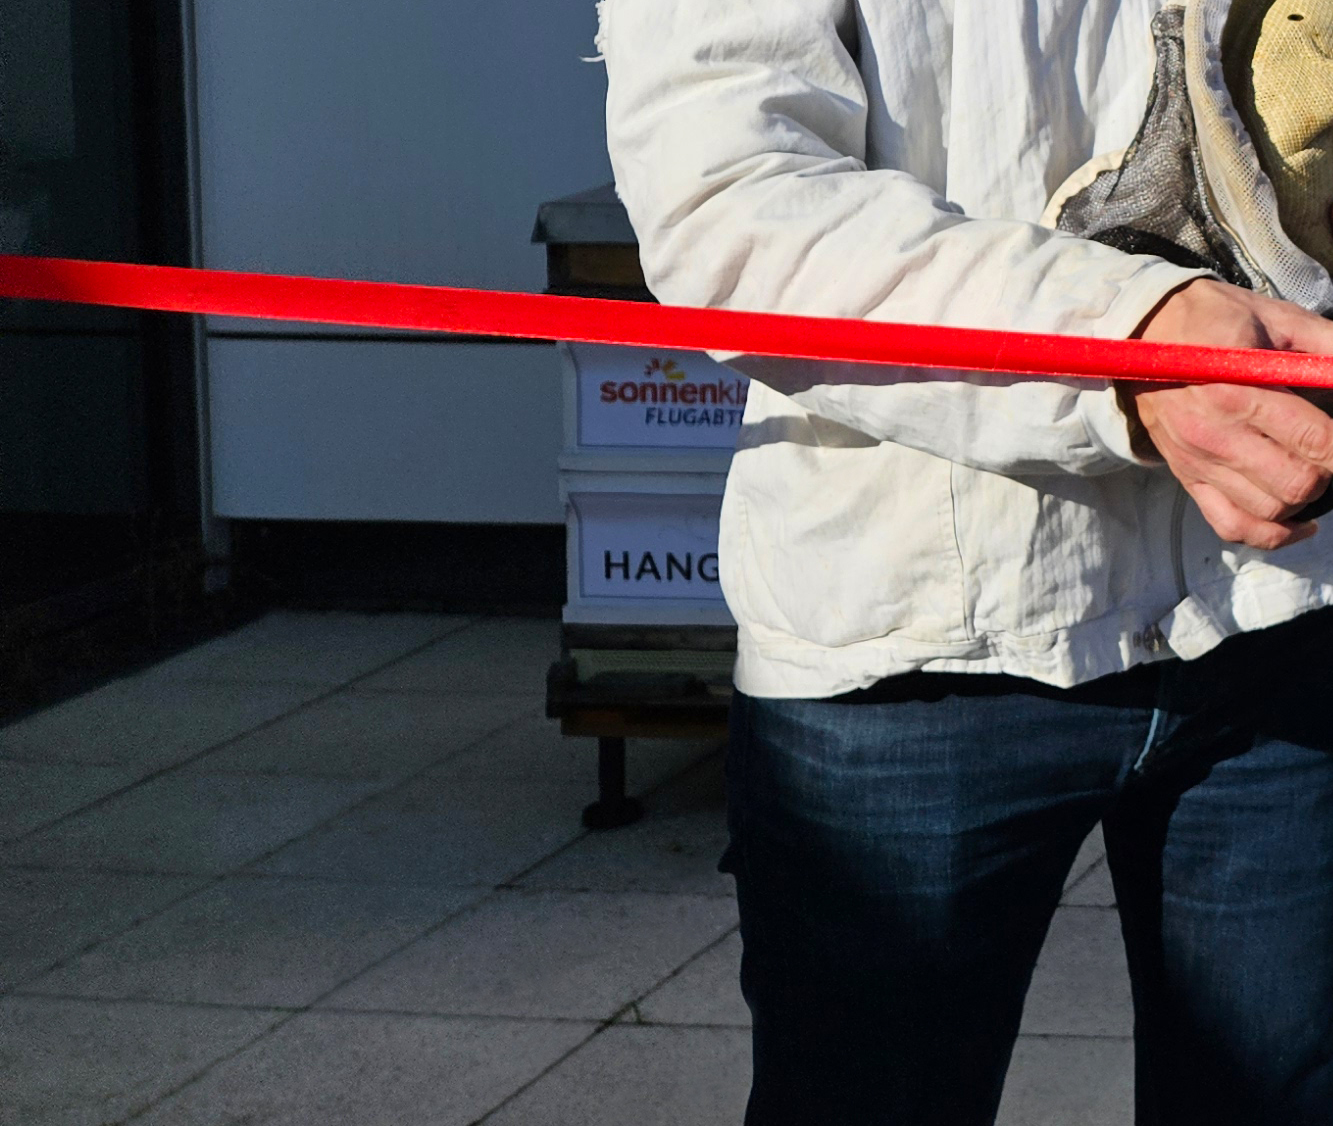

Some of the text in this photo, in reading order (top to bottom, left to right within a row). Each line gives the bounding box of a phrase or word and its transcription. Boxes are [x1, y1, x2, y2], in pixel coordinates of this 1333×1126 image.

[600, 378, 749, 405] sonnenkl
[645, 407, 743, 427] FLUGABT
[603, 550, 719, 582] HANG
